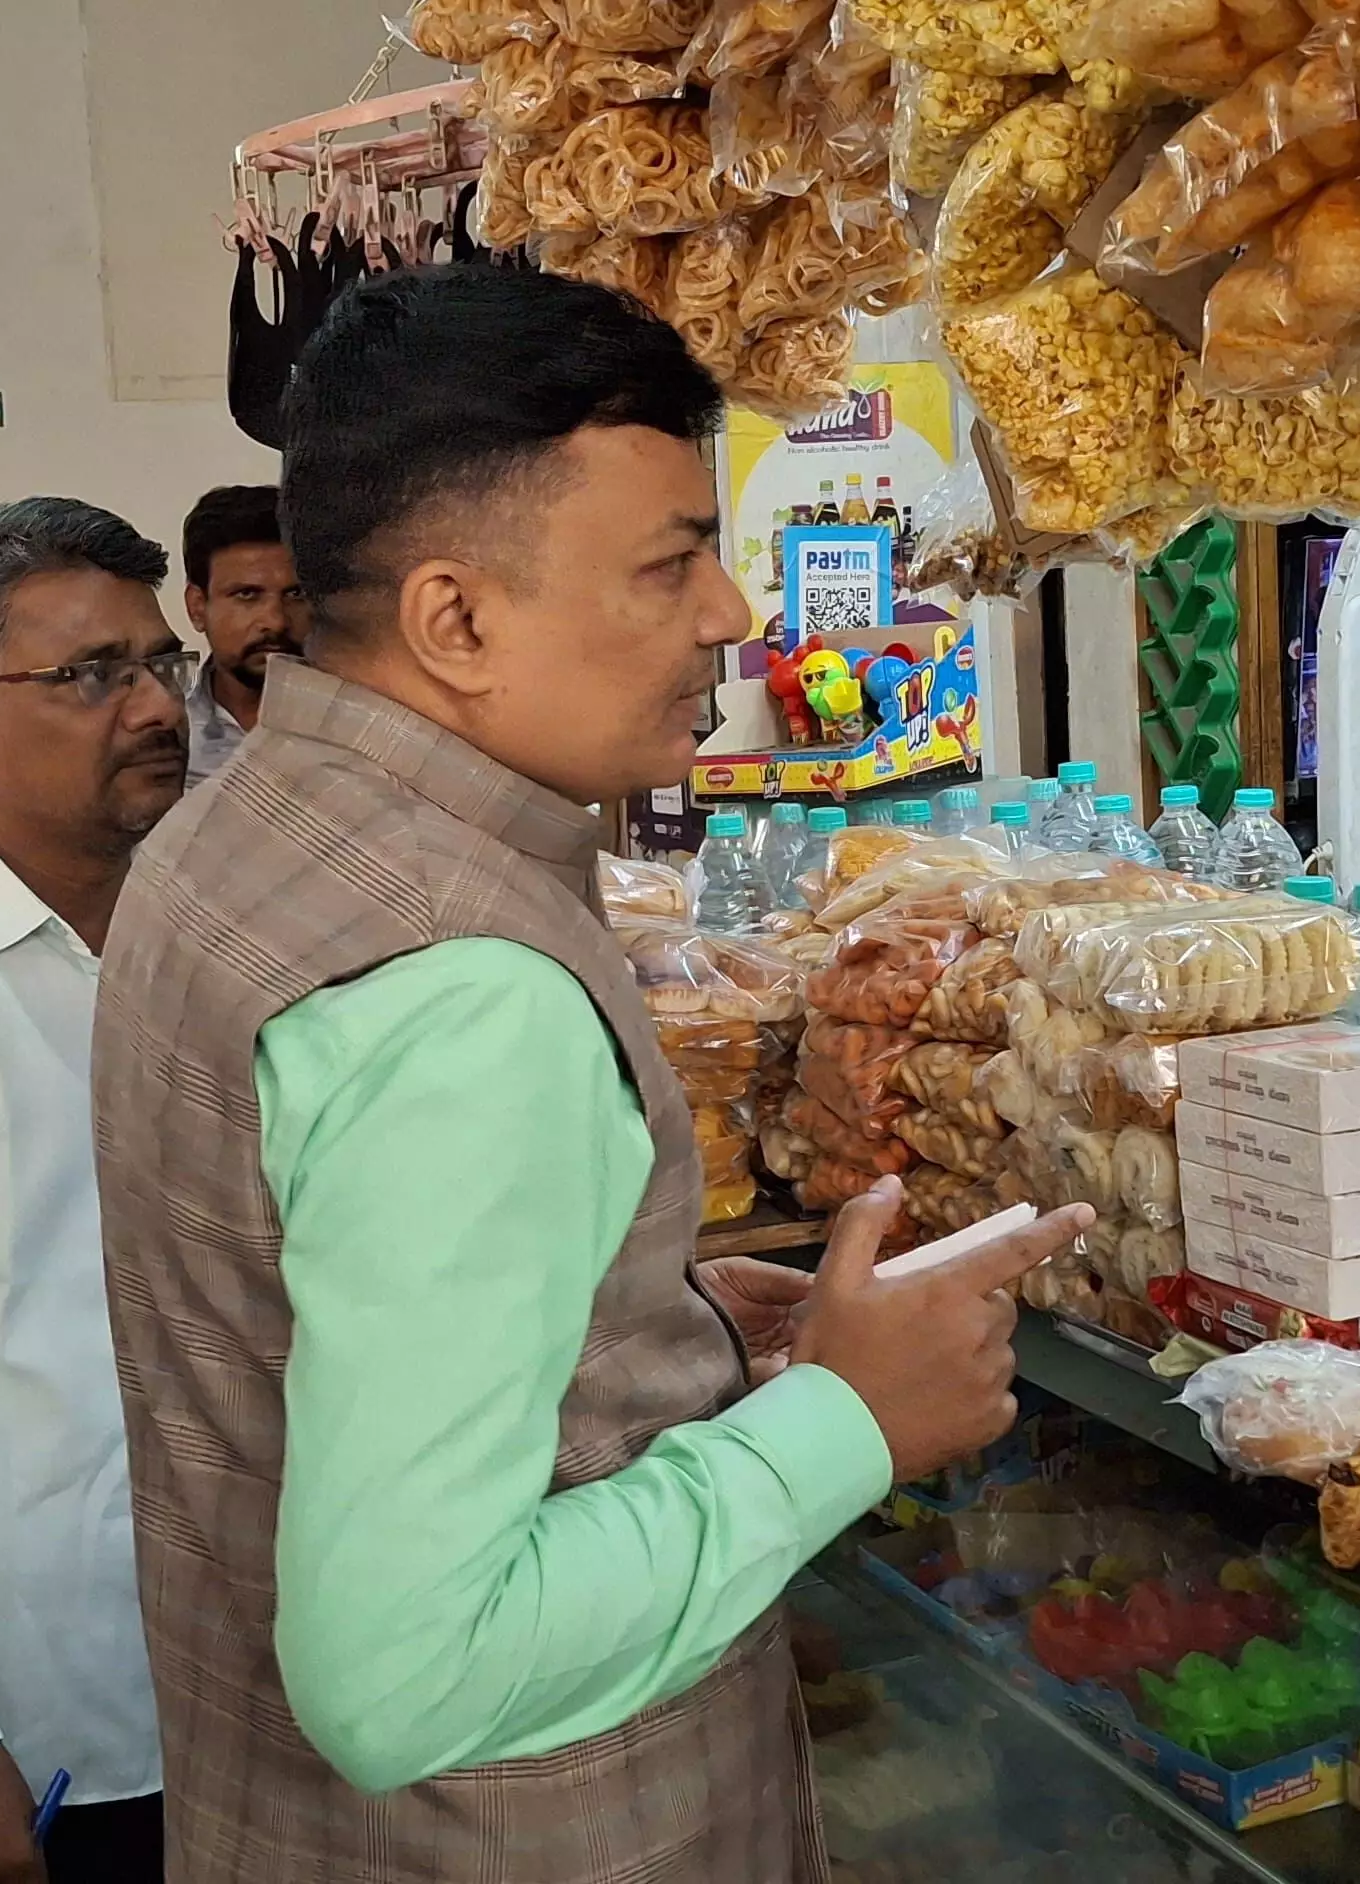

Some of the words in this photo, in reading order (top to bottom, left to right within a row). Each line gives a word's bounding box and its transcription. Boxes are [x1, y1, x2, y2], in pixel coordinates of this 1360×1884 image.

[841, 444, 870, 453] healthy
[806, 572, 848, 582] Accepted
[850, 572, 870, 581] Here
[895, 663, 935, 724] TOP
[905, 709, 930, 753] UP!
[759, 760, 786, 782] TOP
